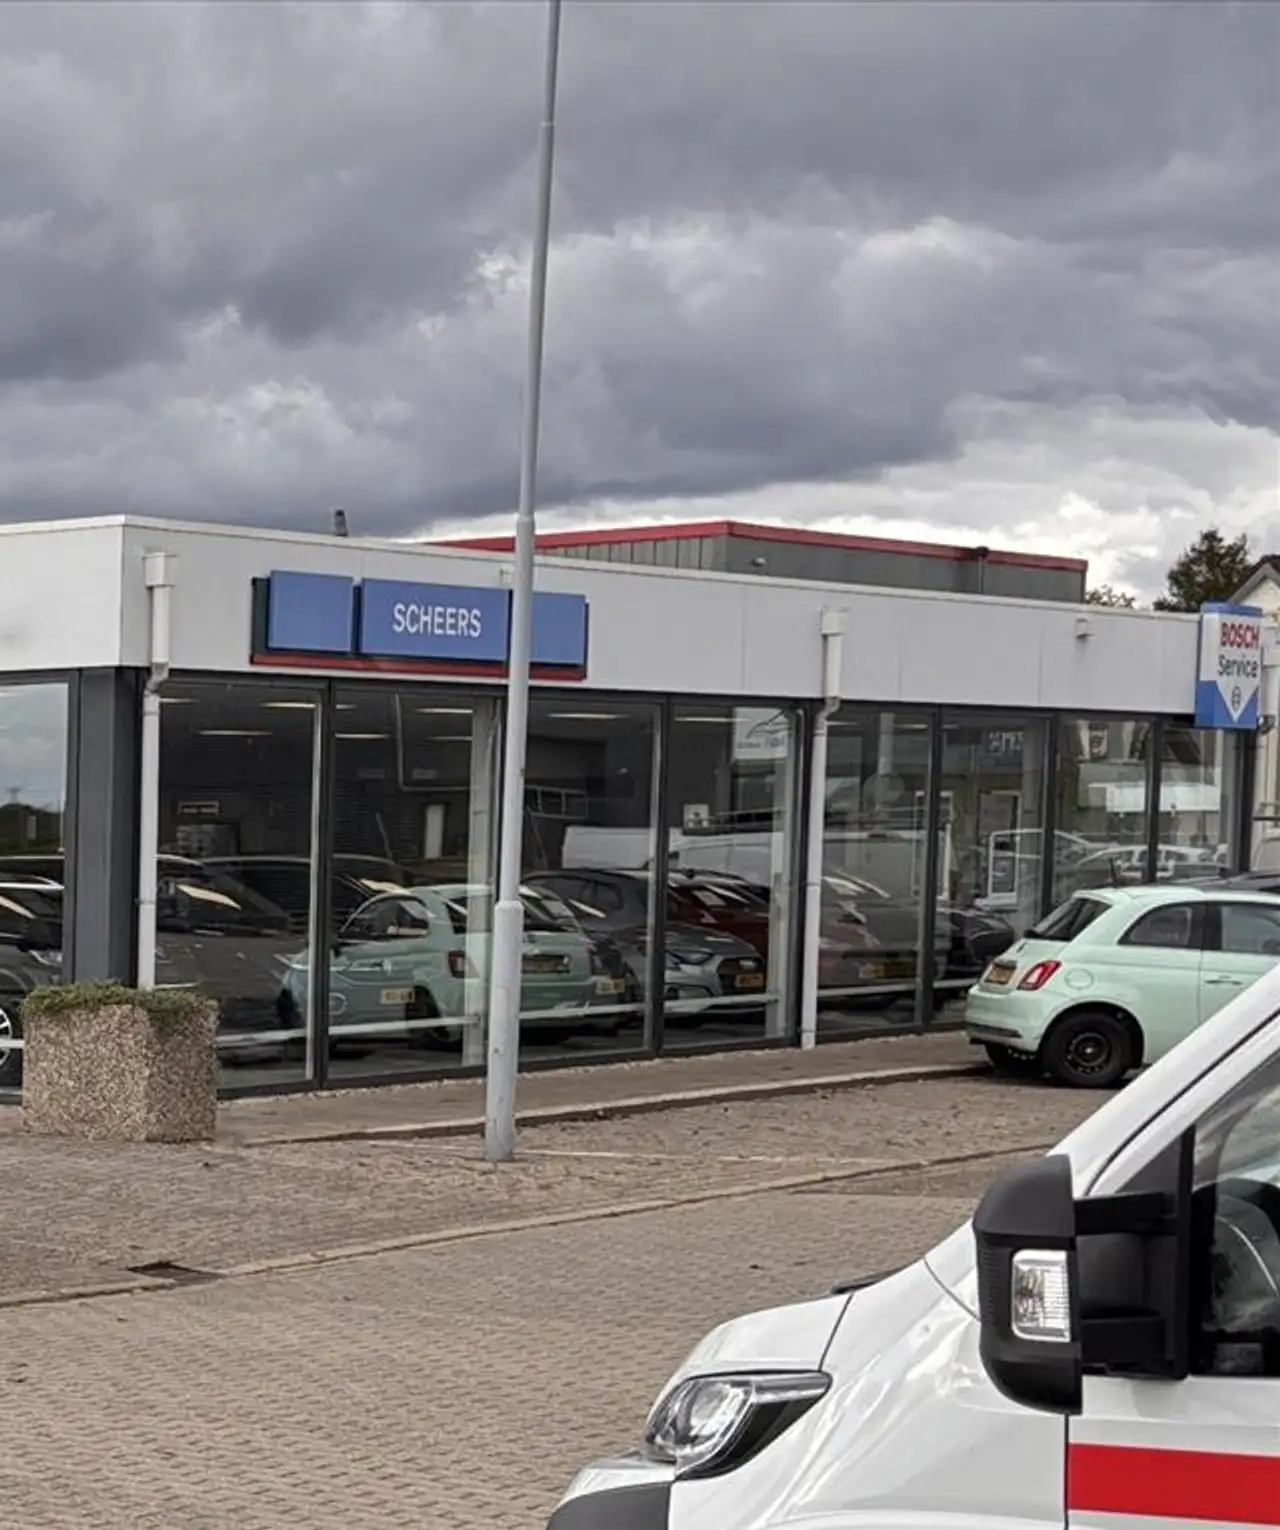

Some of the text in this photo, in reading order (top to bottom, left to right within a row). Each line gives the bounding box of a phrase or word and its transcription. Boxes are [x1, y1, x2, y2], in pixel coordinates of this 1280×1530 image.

[392, 602, 482, 637] SCHEERS
[1220, 621, 1260, 649] BOSCH
[1218, 653, 1258, 679] Service
